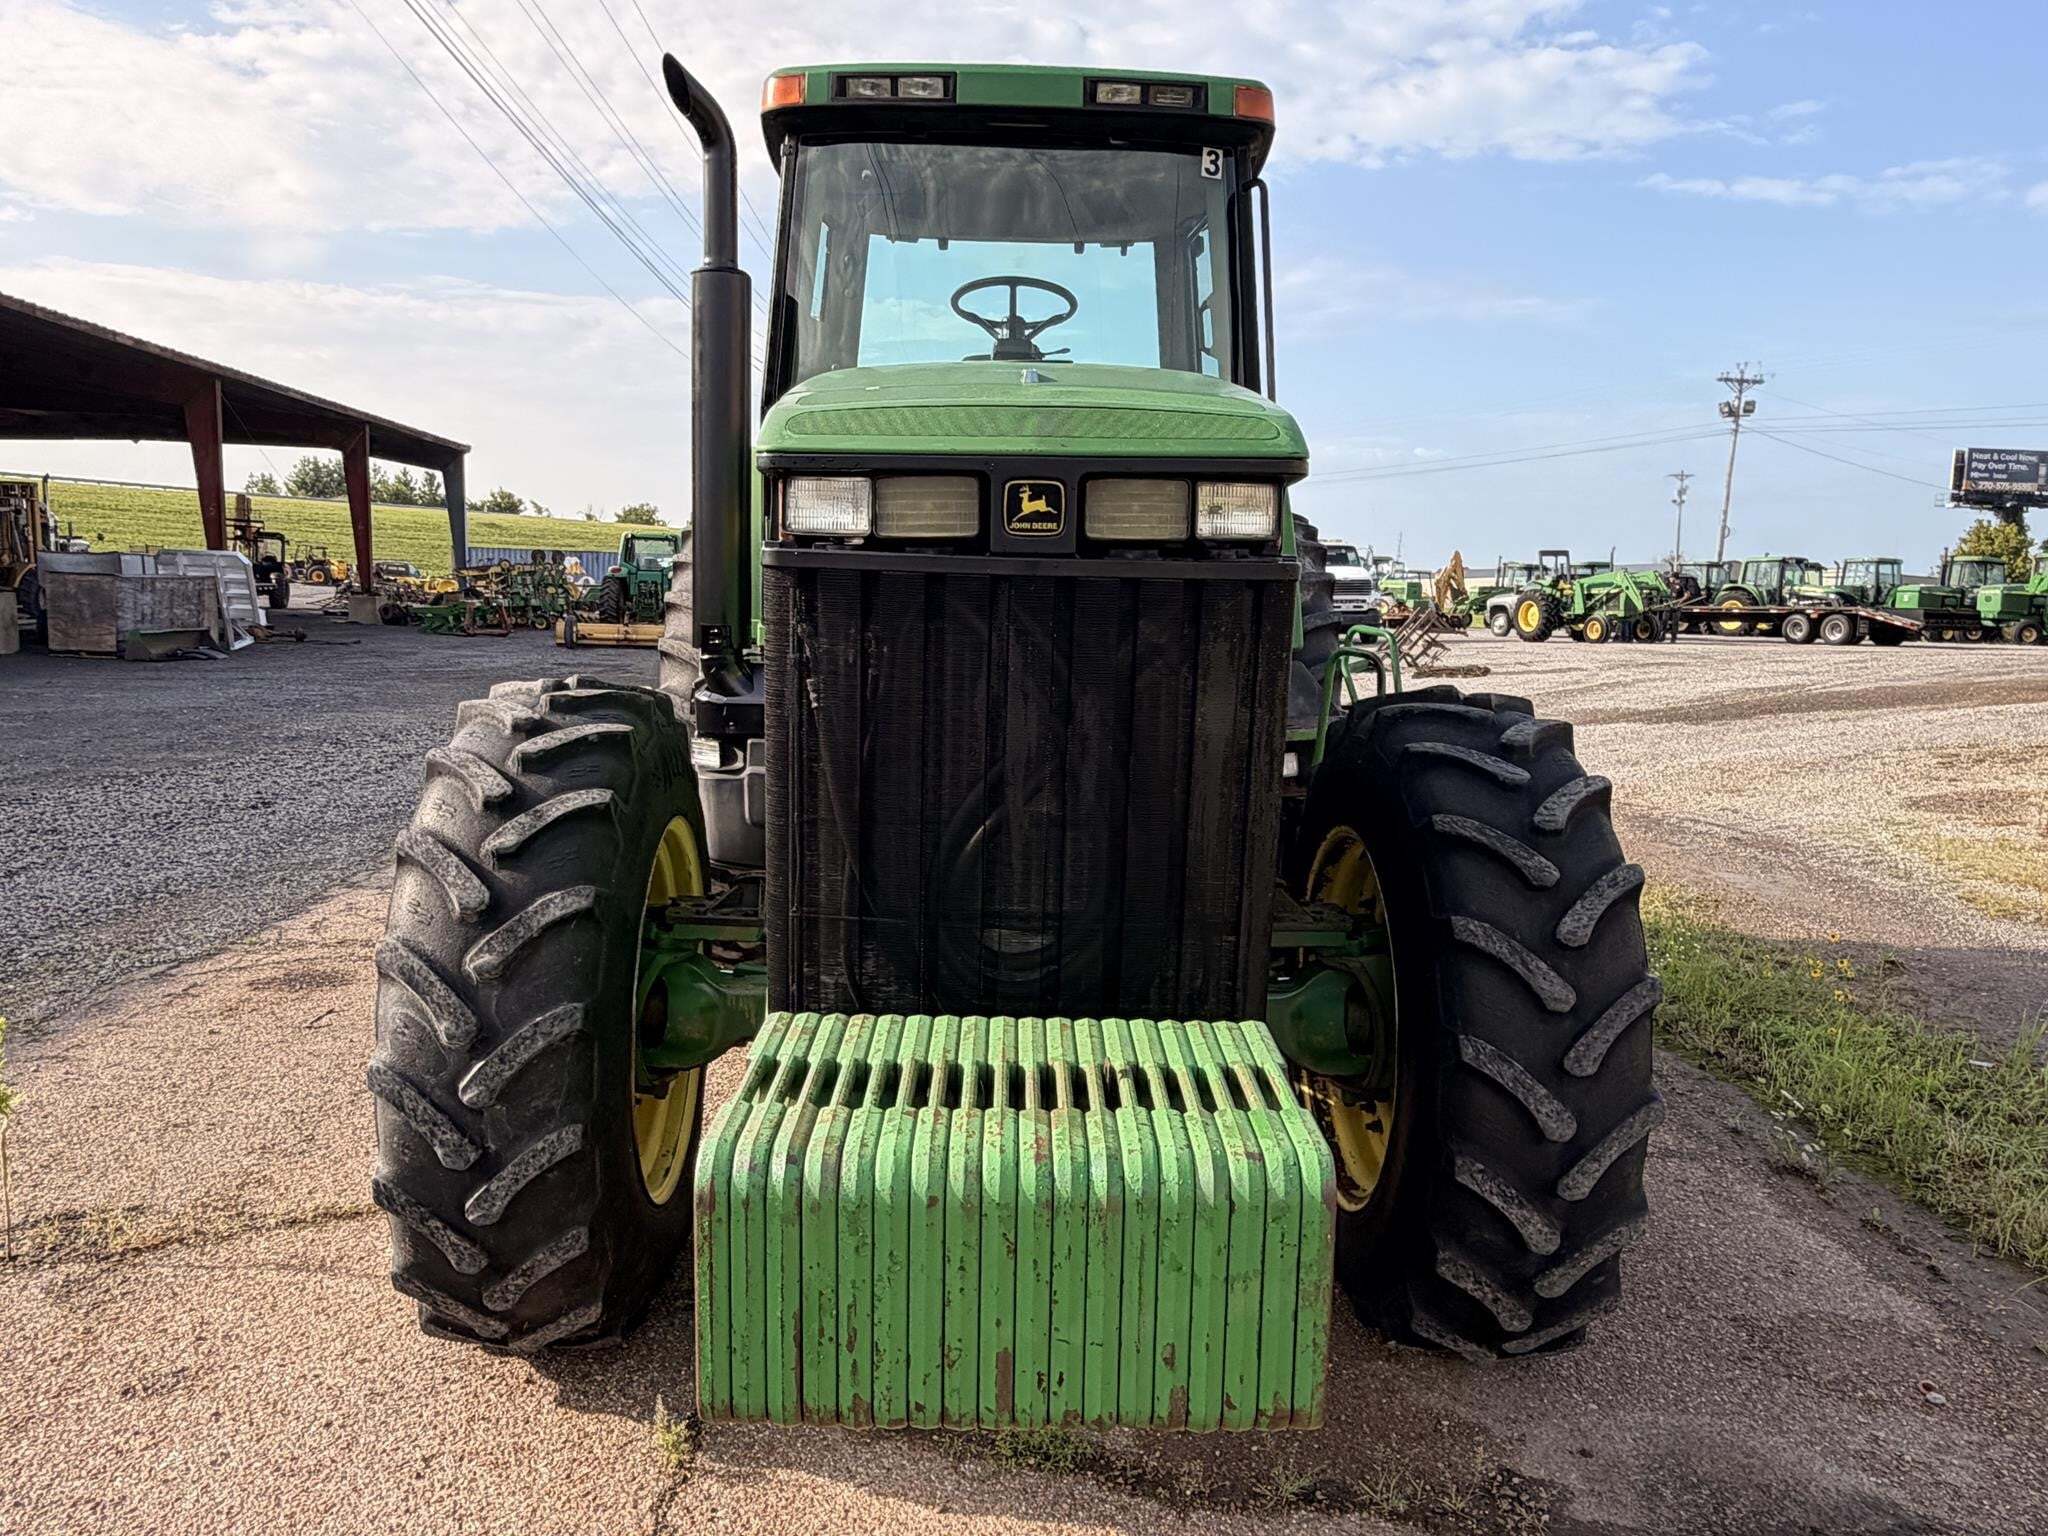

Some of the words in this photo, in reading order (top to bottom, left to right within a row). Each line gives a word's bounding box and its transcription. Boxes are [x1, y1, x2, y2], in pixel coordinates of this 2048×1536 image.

[1204, 150, 1220, 176] 3
[2000, 453, 2017, 461] Cool
[1972, 461, 1986, 470] Pay
[1988, 462, 2006, 470] Over
[2008, 463, 2029, 471] Time.
[1032, 522, 1058, 530] DEERE
